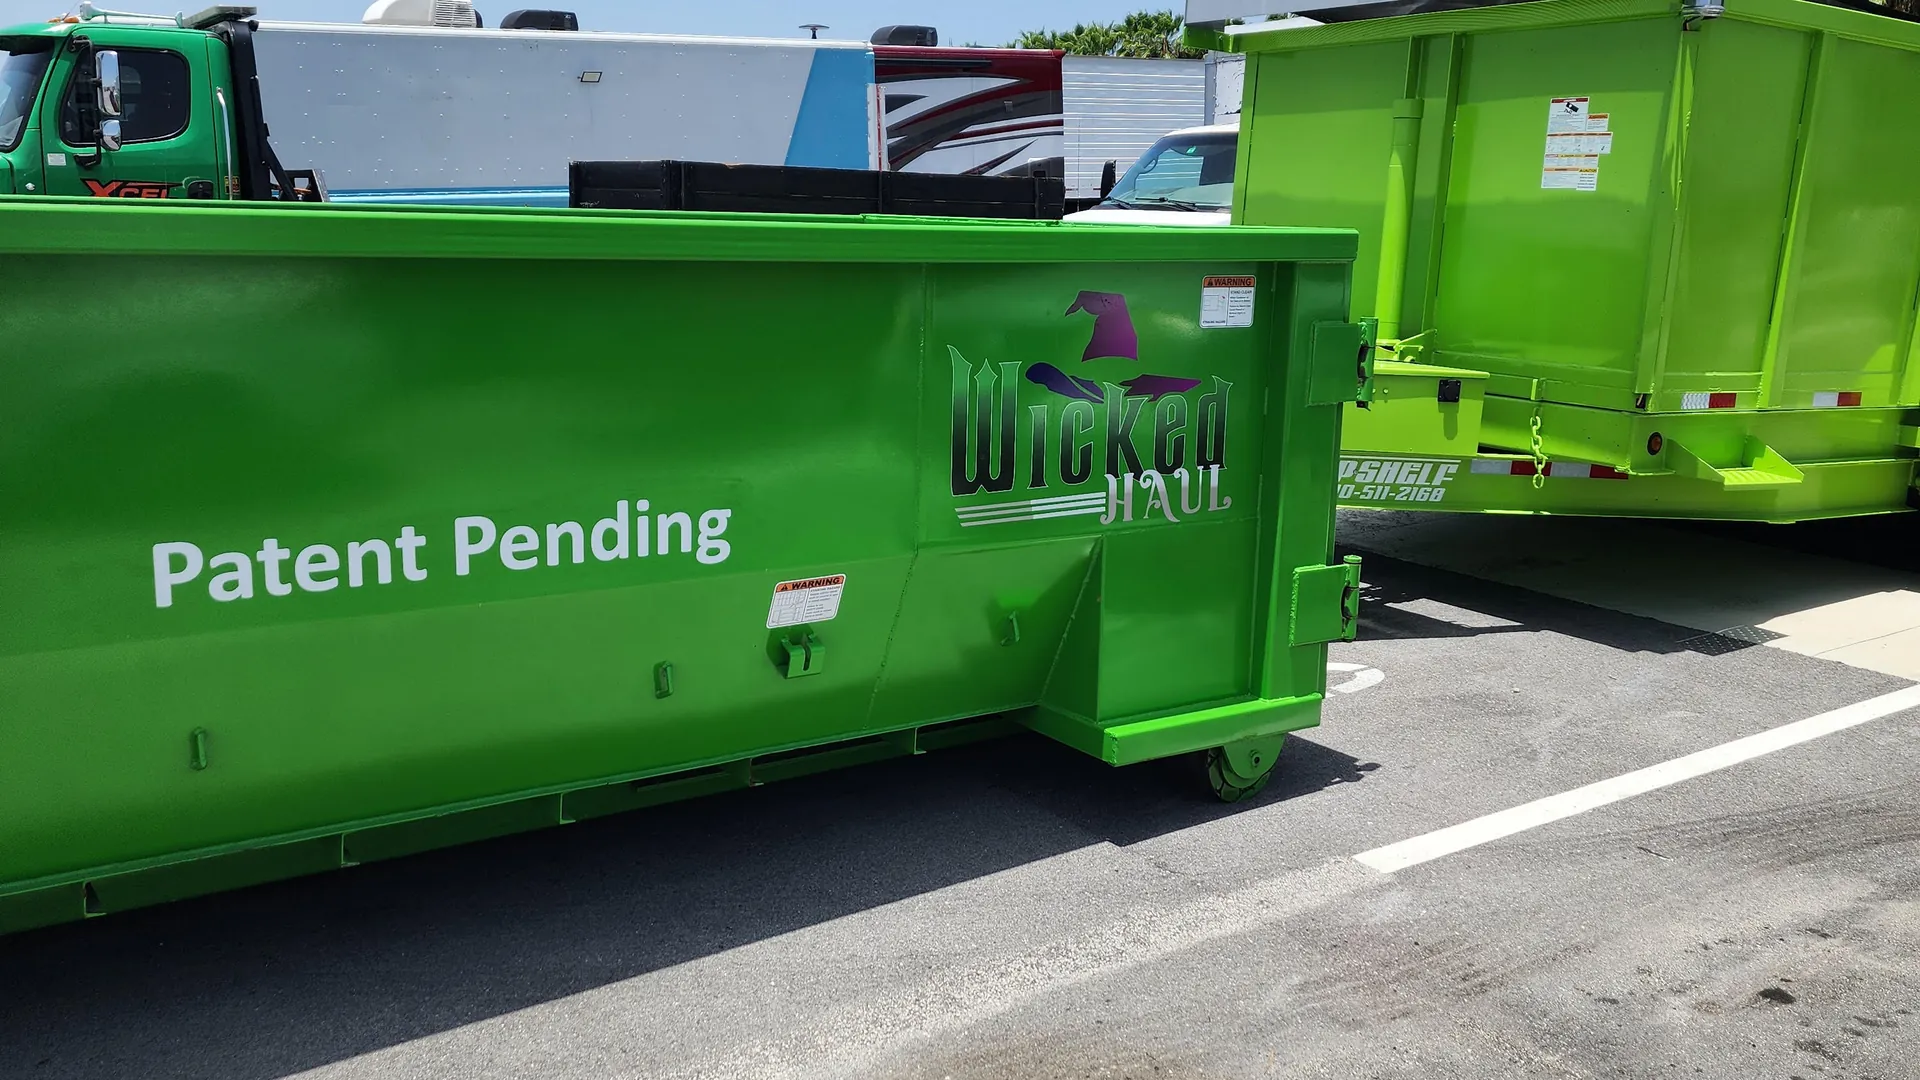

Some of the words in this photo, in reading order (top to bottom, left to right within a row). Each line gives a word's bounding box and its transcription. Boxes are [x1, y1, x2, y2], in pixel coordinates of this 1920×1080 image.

[1214, 278, 1252, 286] WARNING
[947, 345, 1233, 496] Wicked
[1100, 465, 1232, 525] HAUL
[1337, 484, 1446, 502] 0-511-2168
[152, 525, 427, 608] Patent
[453, 499, 732, 576] Pending
[792, 577, 840, 589] WARNING
